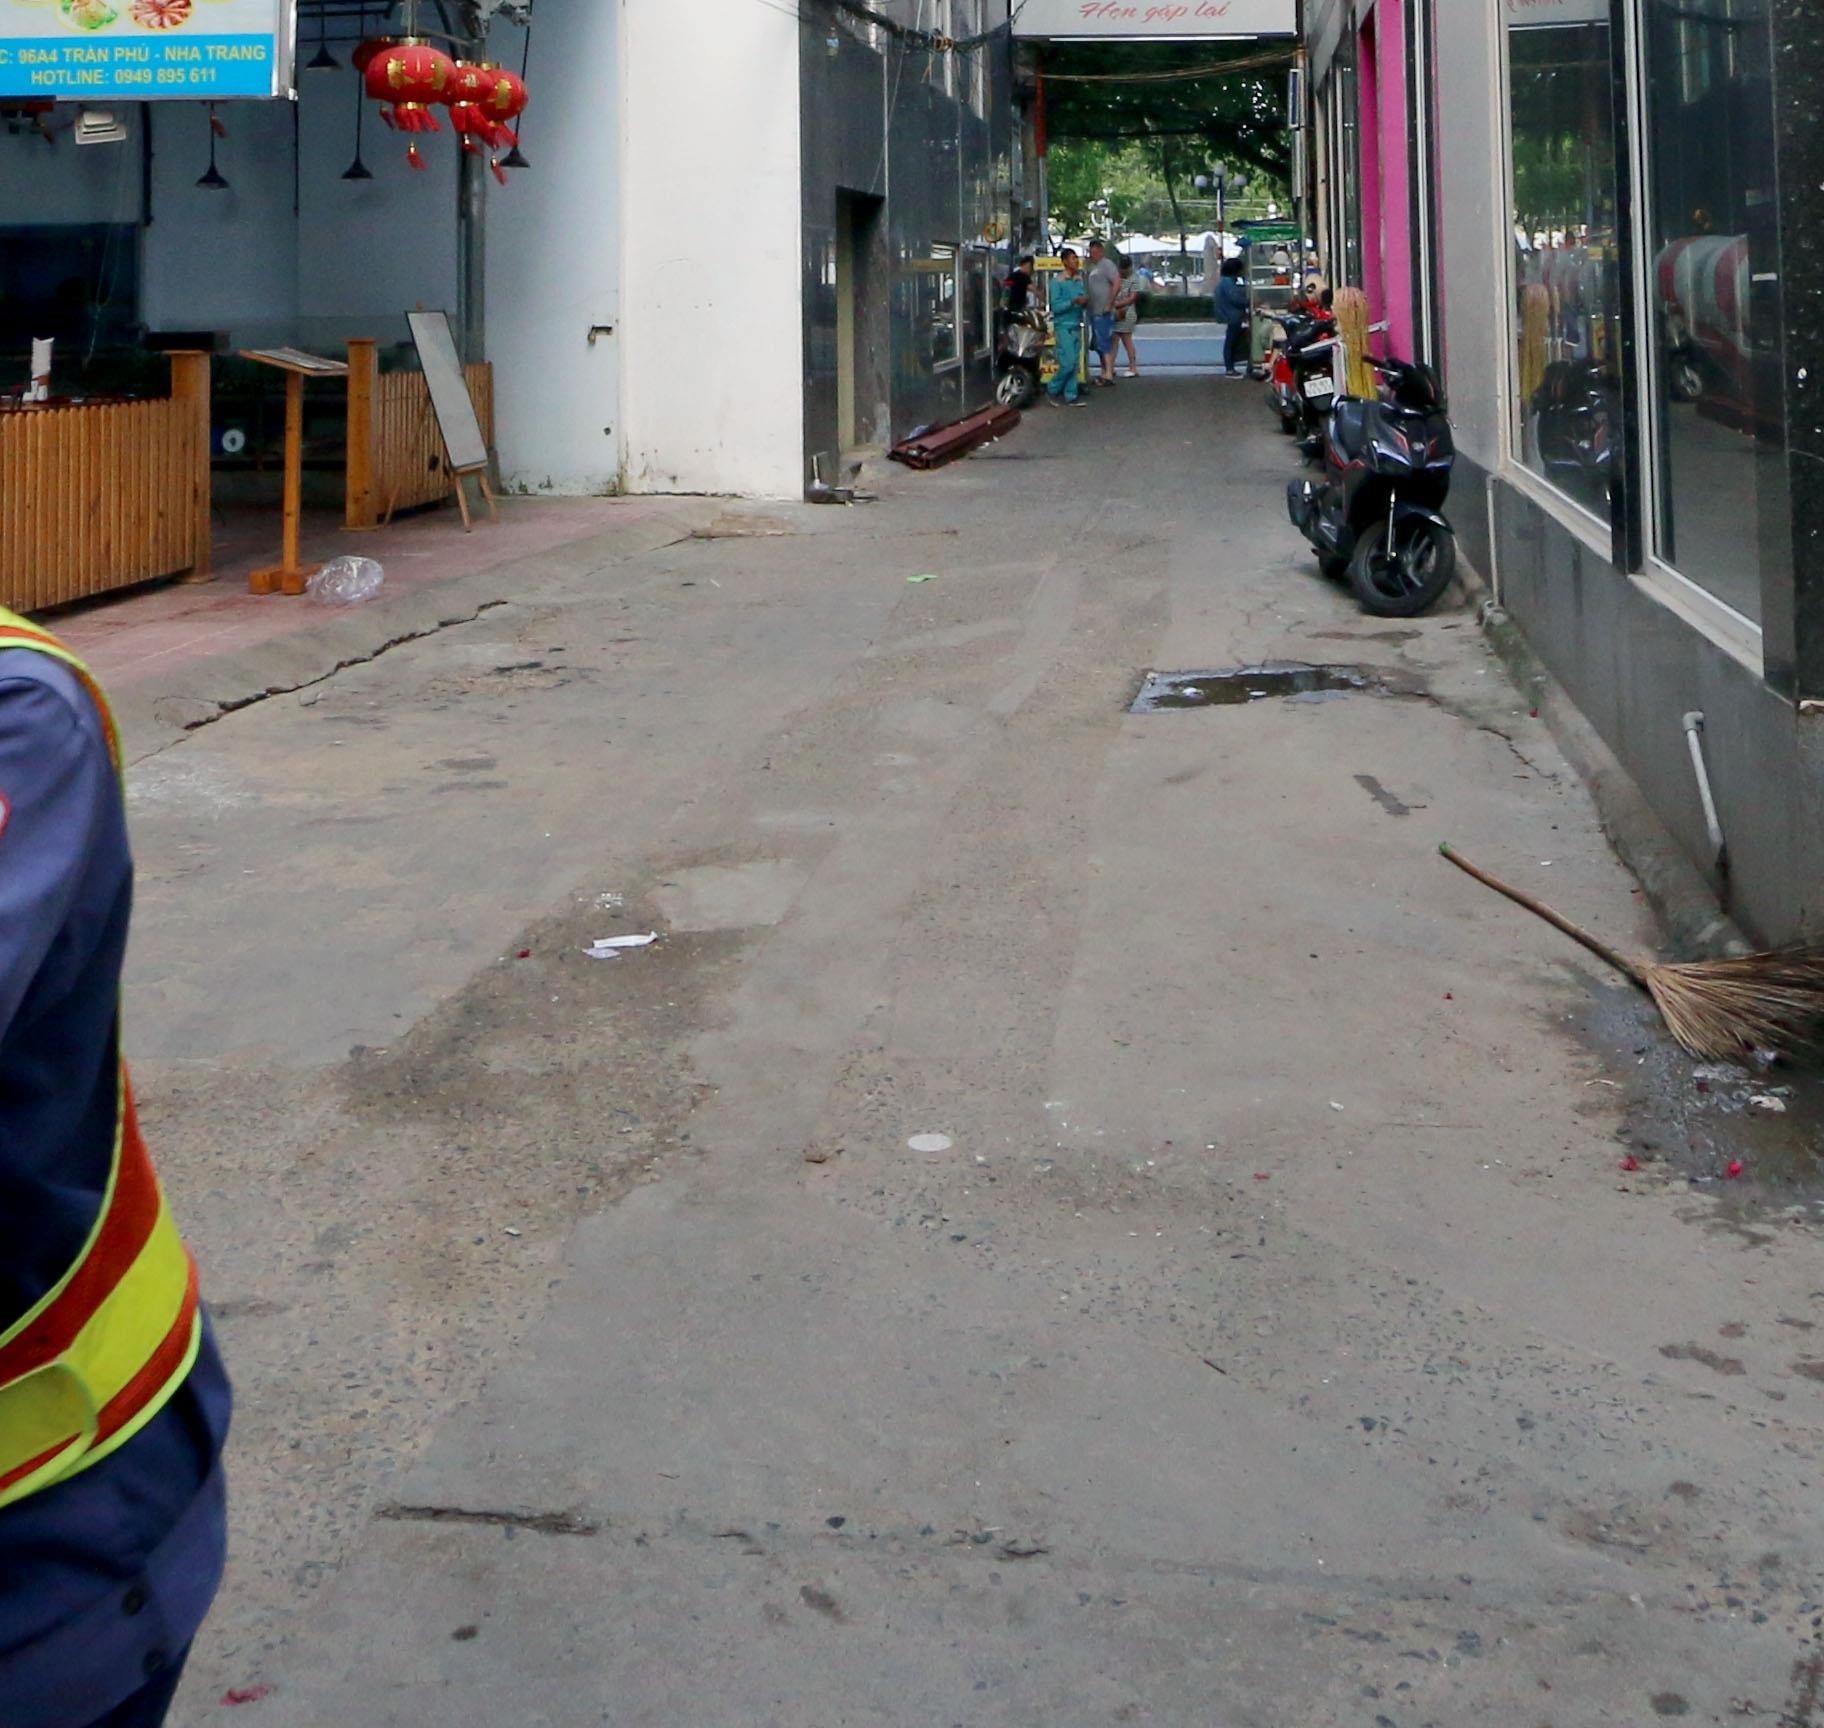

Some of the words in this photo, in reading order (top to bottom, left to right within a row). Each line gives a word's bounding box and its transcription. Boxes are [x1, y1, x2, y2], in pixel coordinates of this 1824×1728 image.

[165, 46, 202, 61] NHA
[205, 45, 267, 61] TRANG
[31, 69, 109, 86] HOTLINE:
